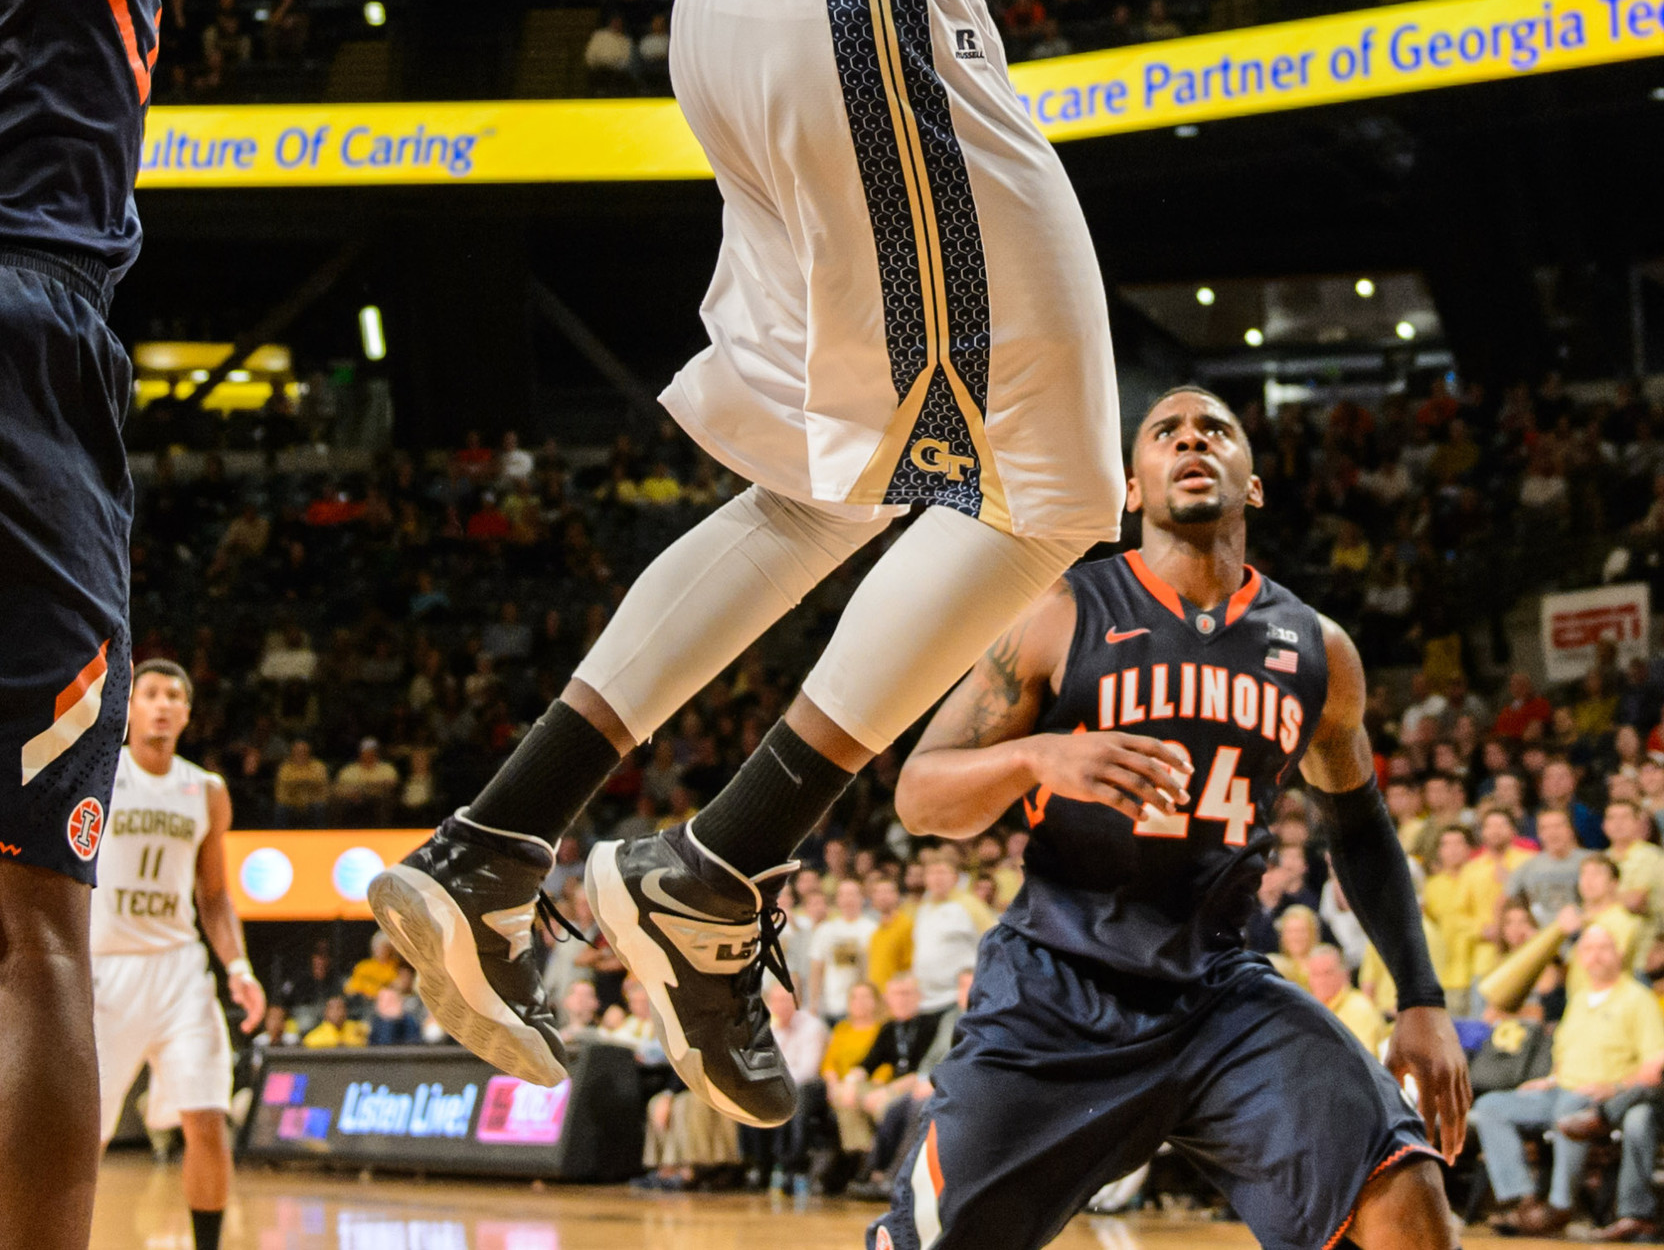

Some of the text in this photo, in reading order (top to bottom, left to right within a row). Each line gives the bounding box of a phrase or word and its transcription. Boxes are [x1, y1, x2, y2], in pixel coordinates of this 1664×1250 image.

[1143, 51, 1317, 109] Partner
[1329, 27, 1377, 82] of
[1390, 2, 1586, 71] Georgia
[275, 125, 331, 169] Of
[340, 124, 477, 177] Caring
[910, 437, 975, 482] GT
[1099, 662, 1304, 754] ILLINOIS
[111, 808, 196, 842] GEORGIA
[137, 843, 166, 881] 11
[114, 888, 179, 916] TECH
[338, 1082, 413, 1136] Listen
[408, 1082, 478, 1138] Live!
